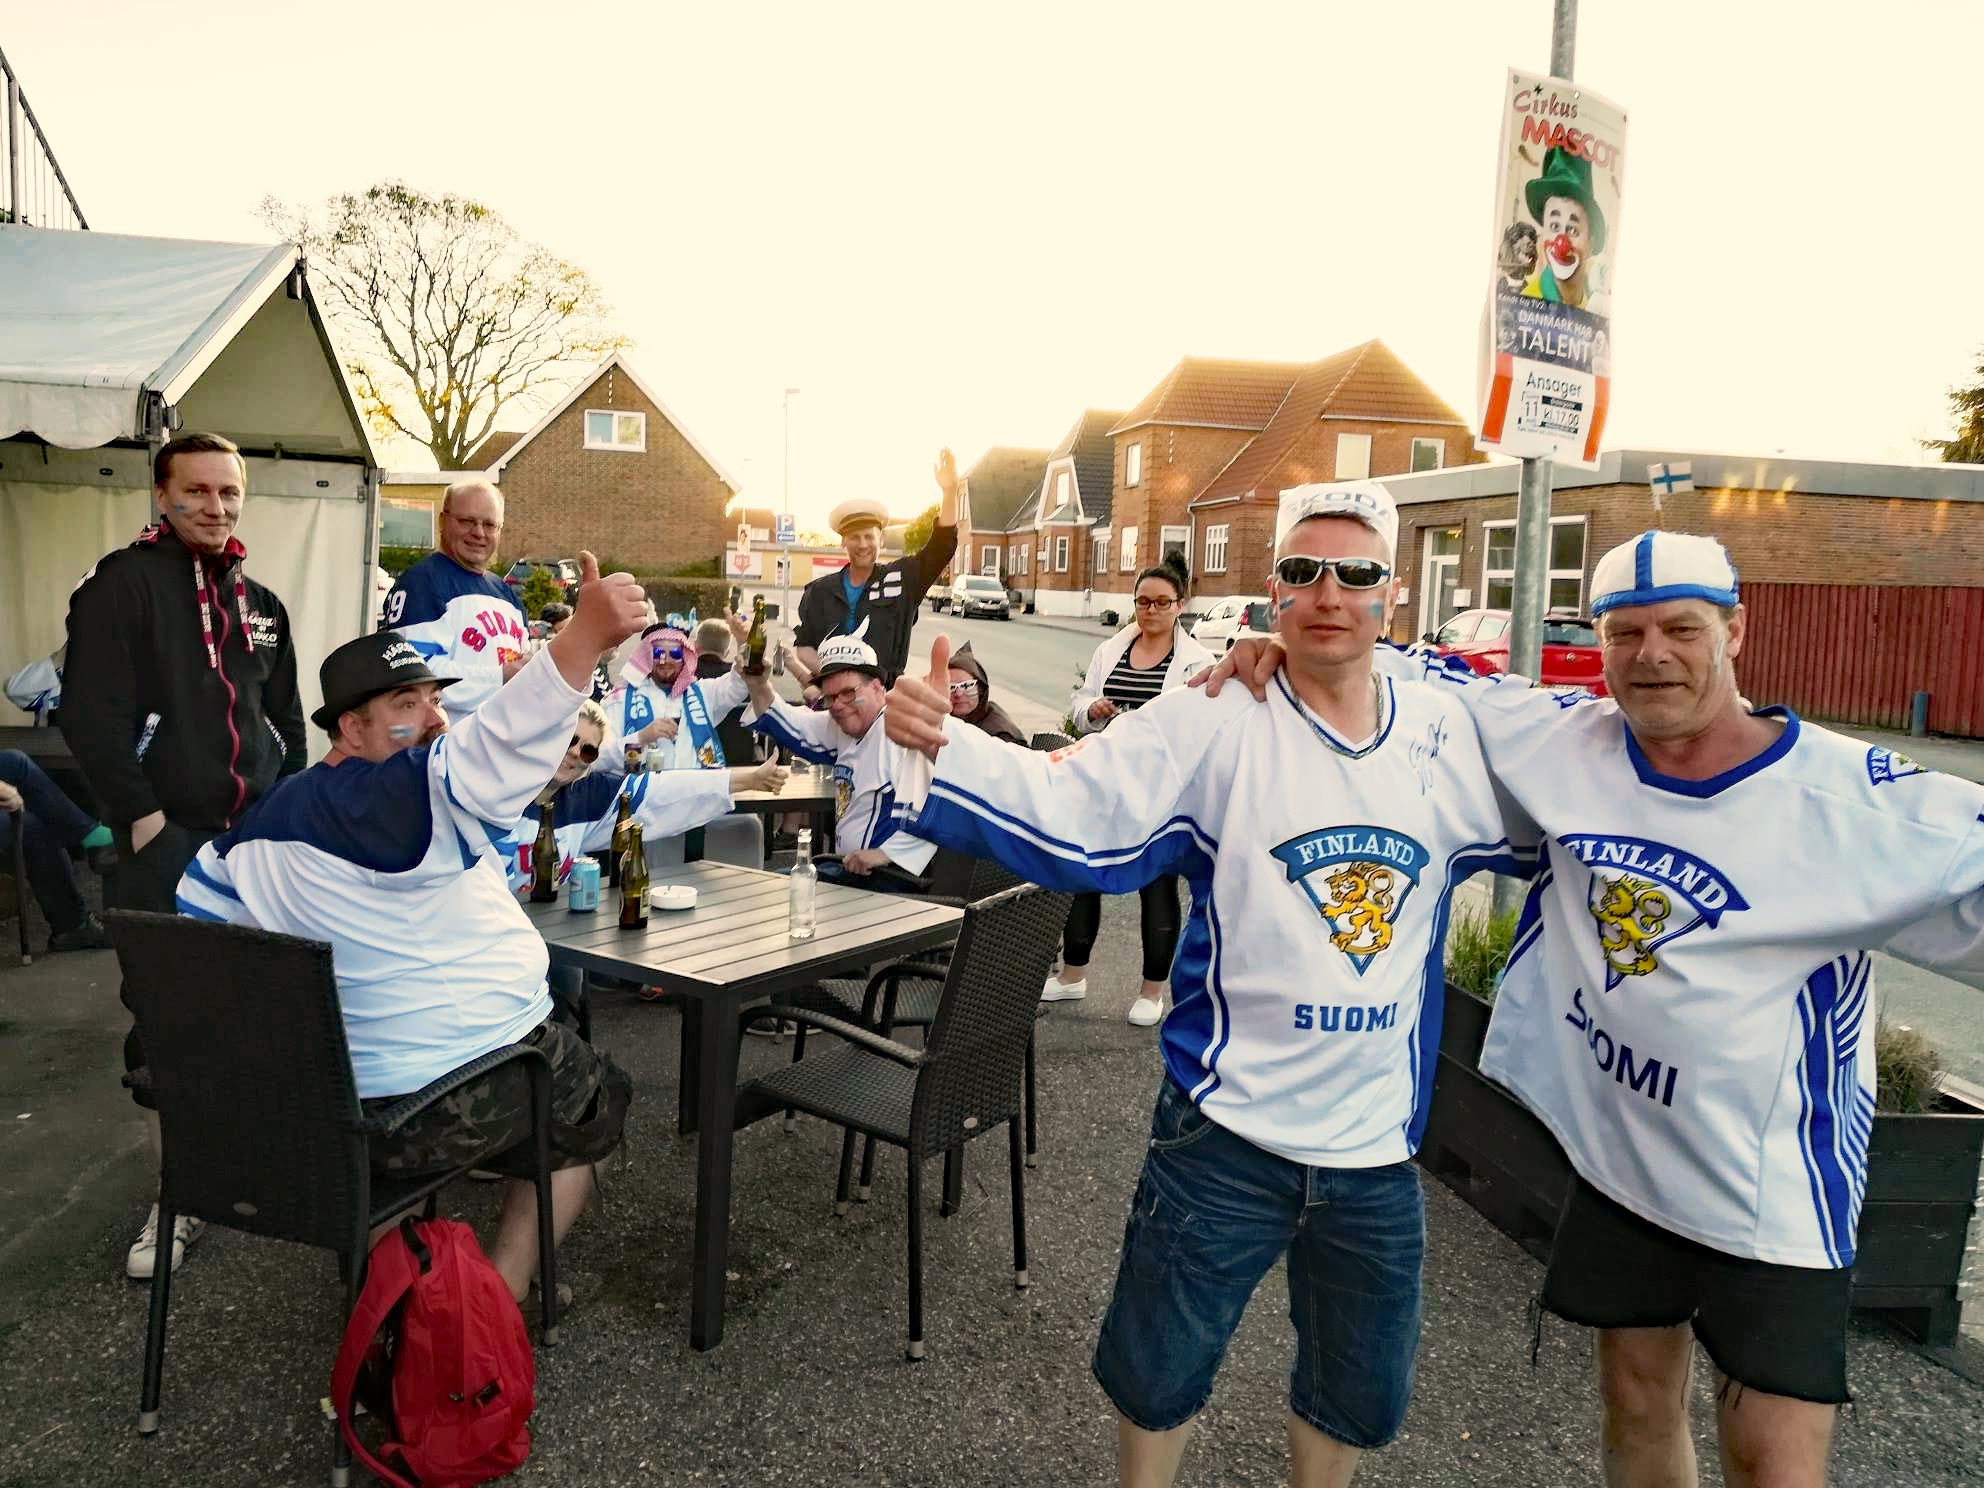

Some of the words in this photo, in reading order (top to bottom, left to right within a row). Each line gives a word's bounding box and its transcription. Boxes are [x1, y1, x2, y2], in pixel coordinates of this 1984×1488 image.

[1513, 90, 1578, 119] Cirkus
[1521, 115, 1620, 172] MASCOT
[1519, 310, 1573, 332] DANMARK
[1518, 325, 1592, 363] TALENT
[1526, 371, 1582, 400] Ansager
[1294, 833, 1416, 866] FINLAND
[1564, 839, 1729, 910] FINLAND
[1294, 1002, 1399, 1033] SUOMI
